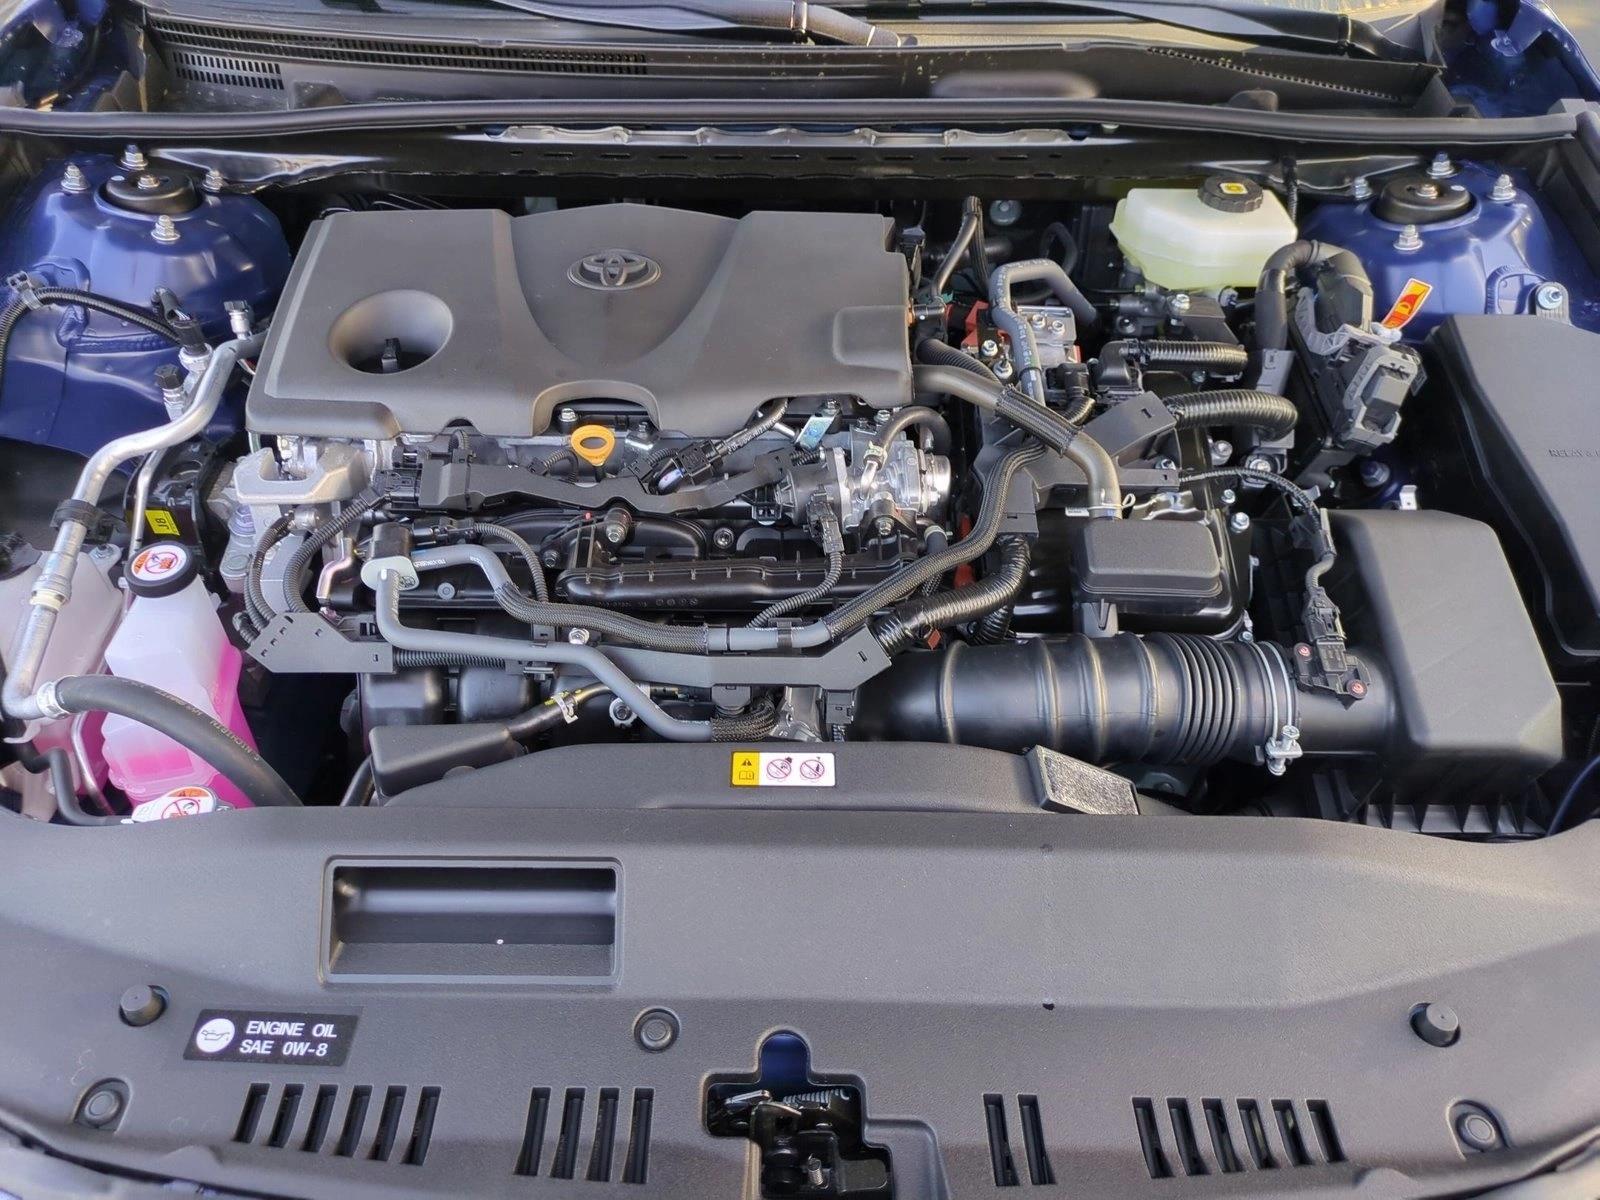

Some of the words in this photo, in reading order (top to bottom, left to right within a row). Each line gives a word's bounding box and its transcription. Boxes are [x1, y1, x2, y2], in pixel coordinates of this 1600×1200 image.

[245, 1020, 304, 1036] ENGINE
[311, 1023, 338, 1038] OIL
[239, 1039, 274, 1055] SAE
[282, 1041, 328, 1057] 0W-8
